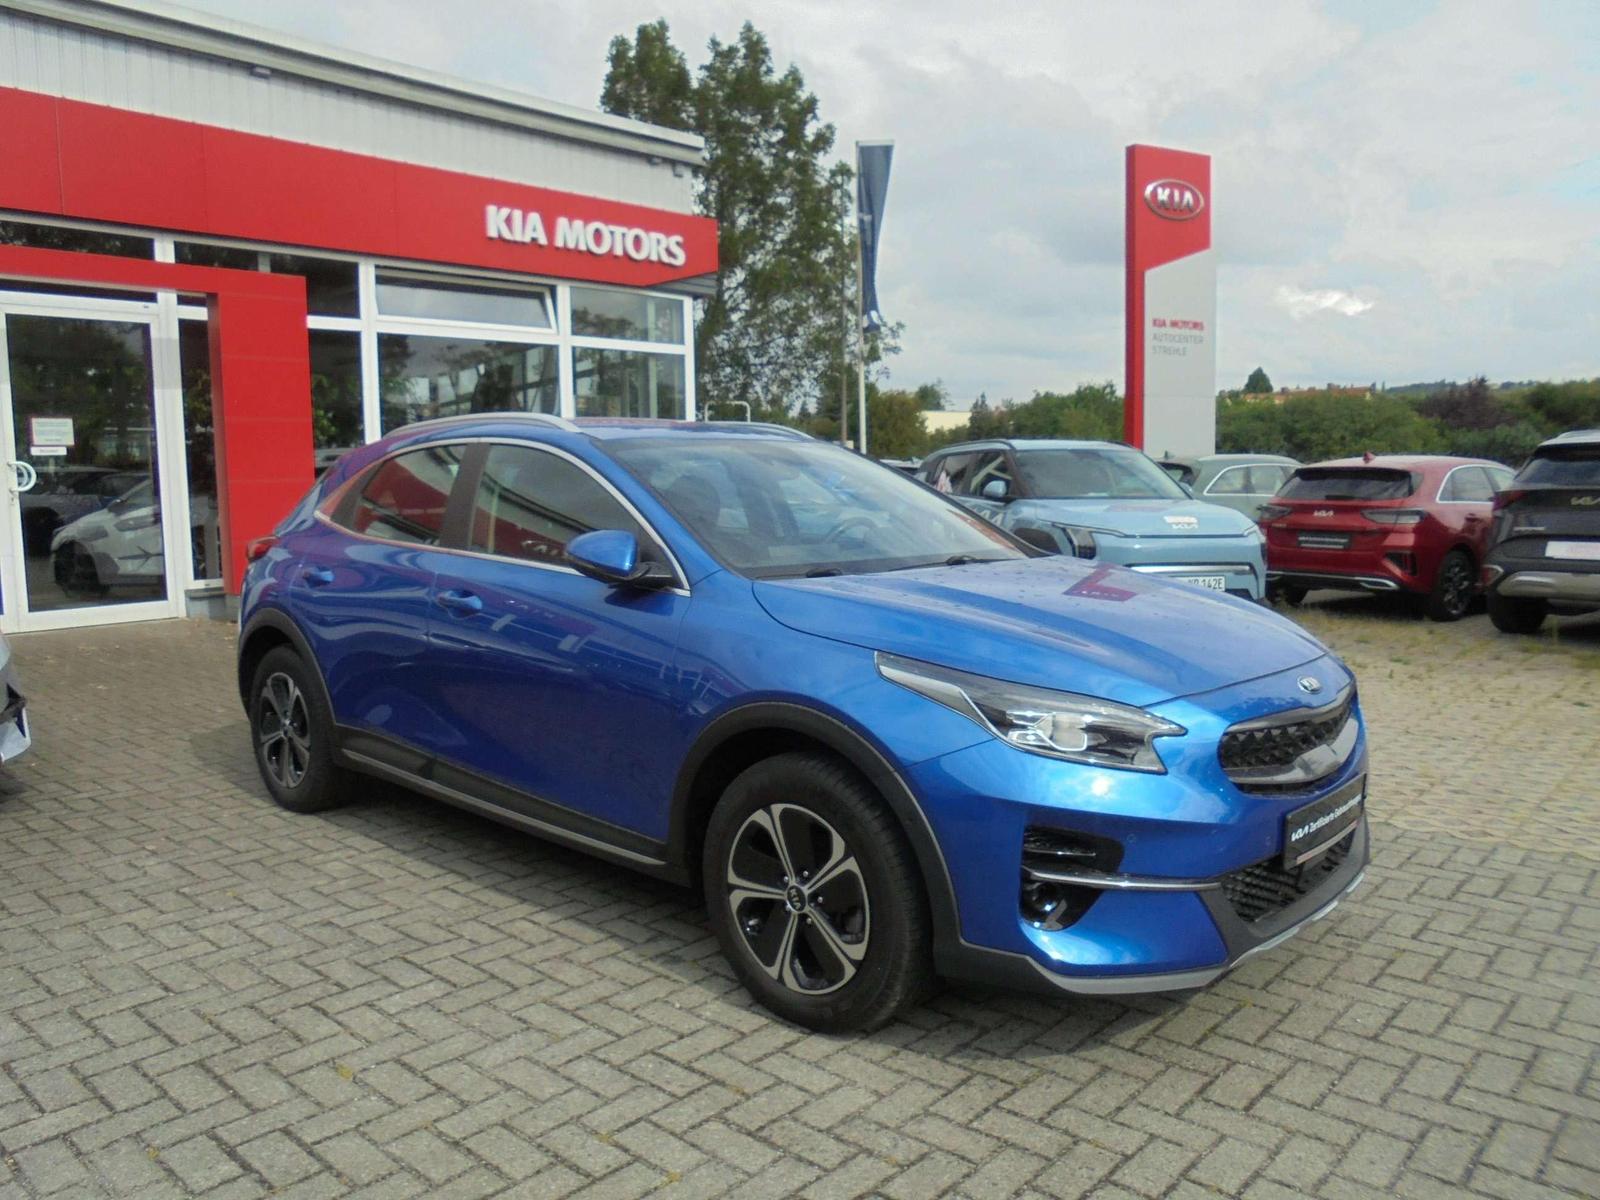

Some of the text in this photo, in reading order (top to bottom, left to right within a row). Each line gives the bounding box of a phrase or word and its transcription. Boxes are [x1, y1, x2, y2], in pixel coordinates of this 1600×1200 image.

[1157, 186, 1194, 211] KIA
[485, 204, 687, 267] KIA MOTORS
[1152, 318, 1205, 332] KIA MOTORS
[1152, 332, 1204, 345] AUTOCENTER
